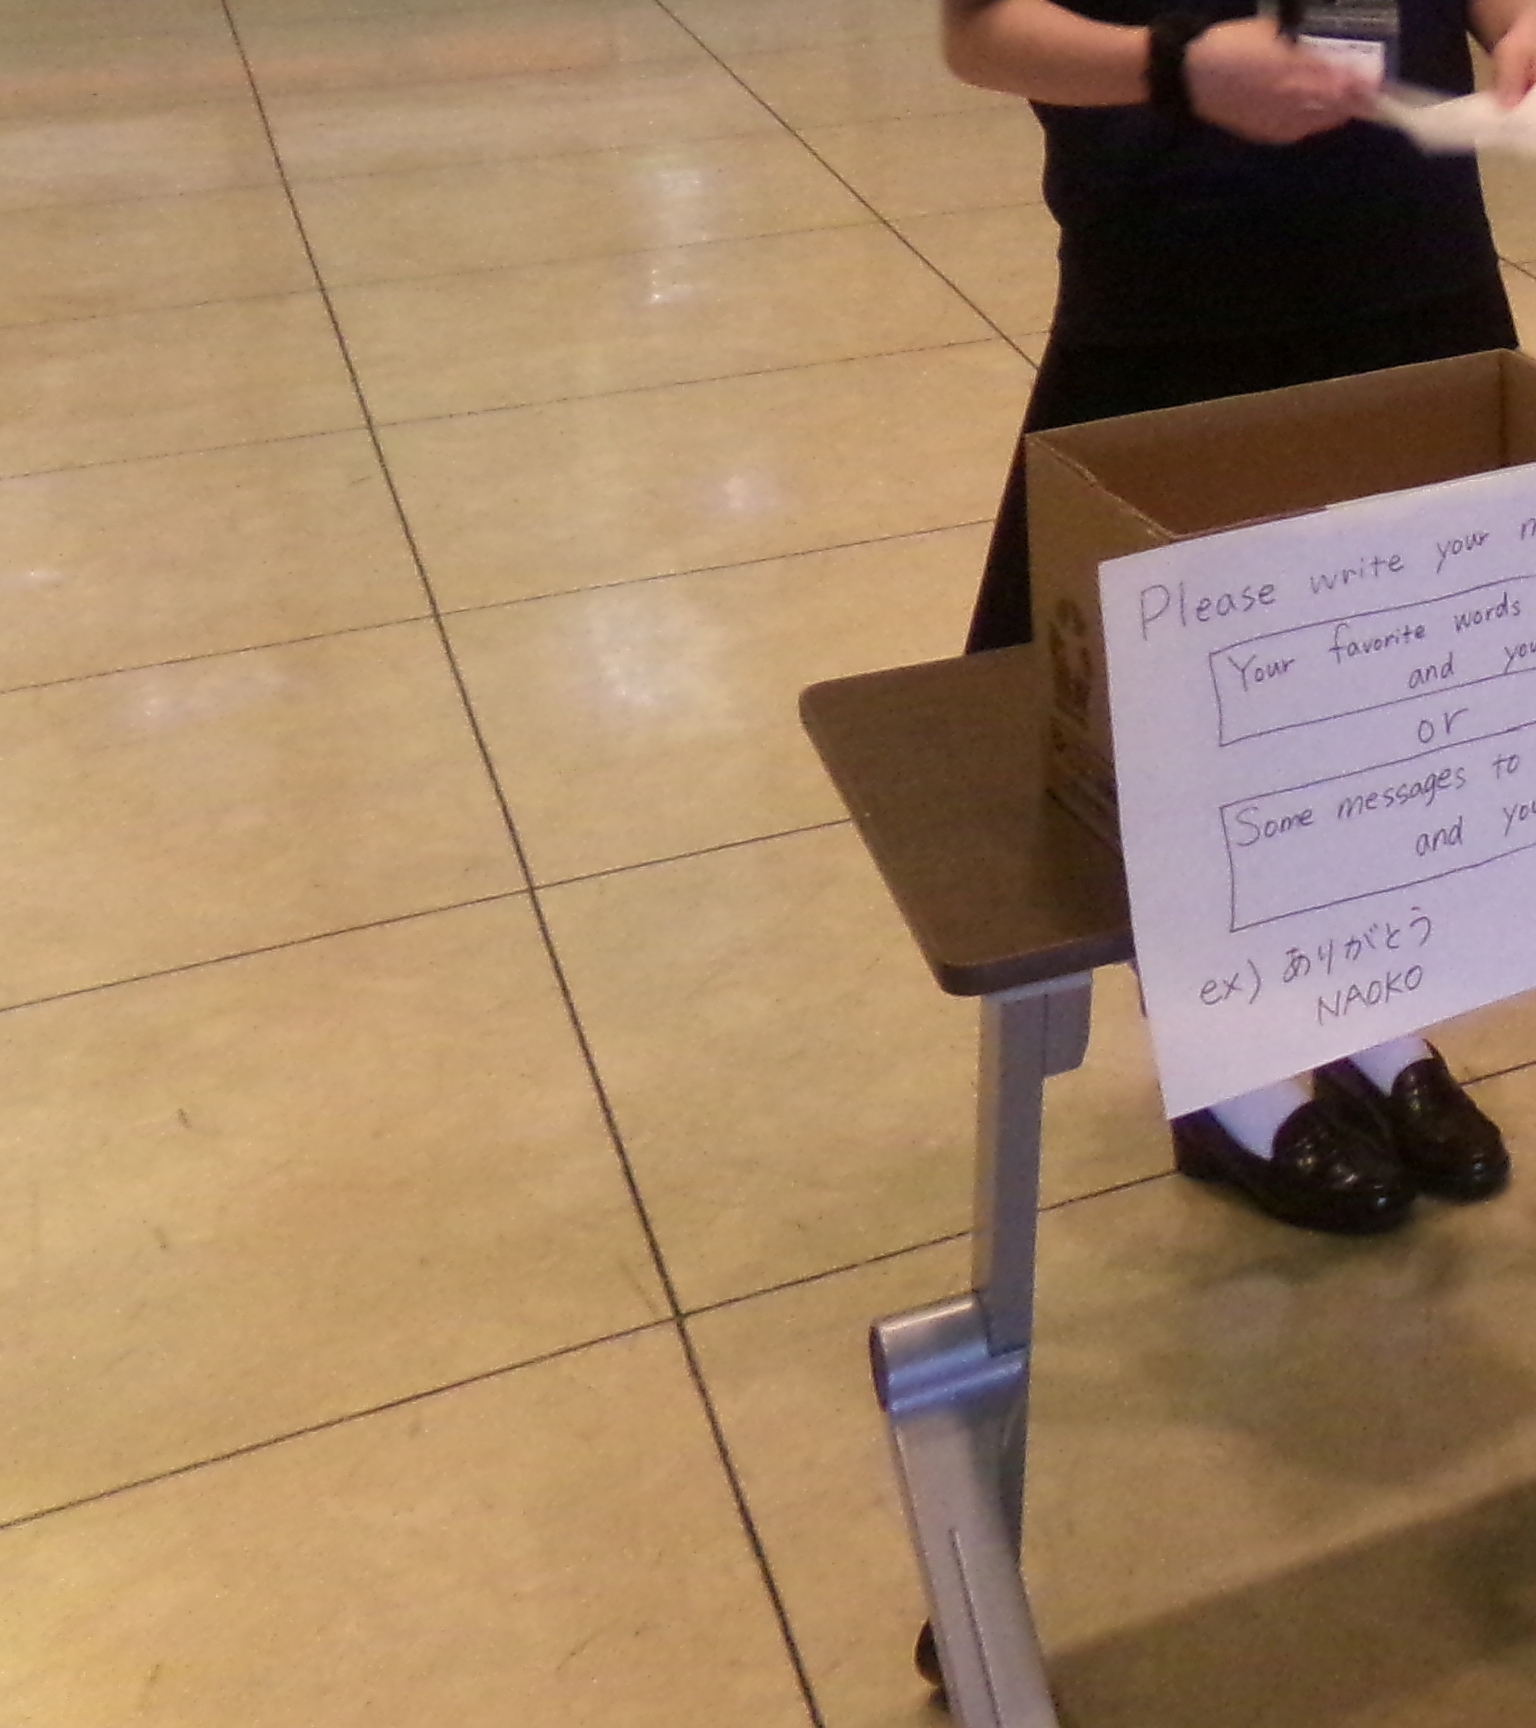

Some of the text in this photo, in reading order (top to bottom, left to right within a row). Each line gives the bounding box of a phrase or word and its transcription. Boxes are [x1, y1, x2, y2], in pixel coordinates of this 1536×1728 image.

[1140, 581, 1276, 641] Please
[1310, 554, 1405, 594] write
[1435, 530, 1490, 574] your
[1228, 591, 1522, 692] Your favorite words
[1407, 651, 1454, 690] and
[1417, 707, 1470, 744] or
[1235, 806, 1314, 848] Some
[1336, 766, 1467, 821] messages
[1492, 752, 1520, 780] to
[1415, 815, 1464, 857] and
[1199, 905, 1432, 1006] ex) ありがとう
[1316, 964, 1424, 1027] NAOKO
